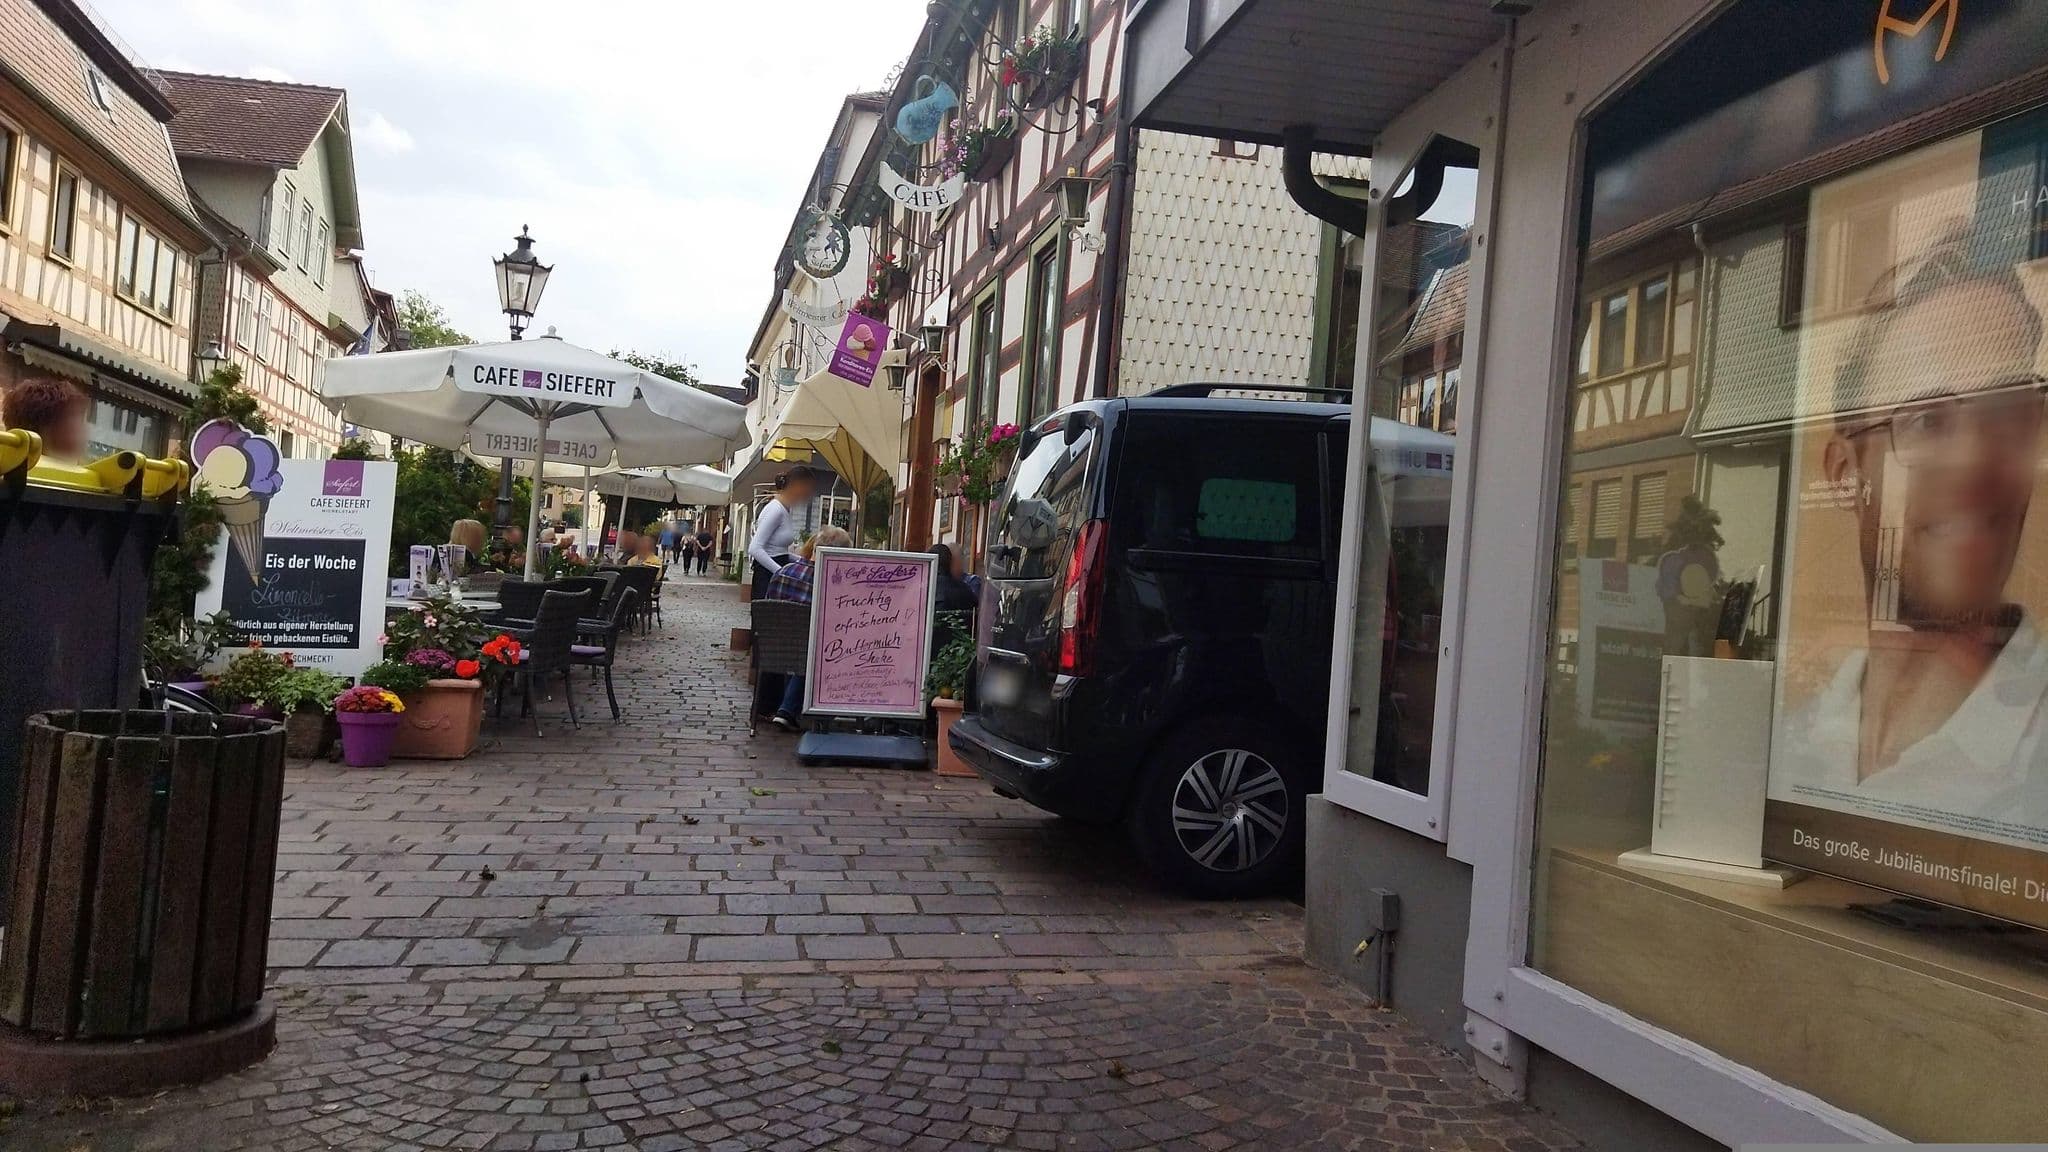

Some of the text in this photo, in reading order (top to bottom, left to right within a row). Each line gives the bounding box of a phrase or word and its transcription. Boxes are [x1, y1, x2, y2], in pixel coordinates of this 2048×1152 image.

[473, 365, 519, 387] CAFE
[546, 372, 617, 398] SIEFERT
[310, 498, 371, 509] CAFE SIEFERT
[265, 553, 357, 570] Eis der Woche
[263, 621, 277, 630] aus
[278, 621, 308, 632] eigener
[310, 621, 354, 633] Herstellung
[274, 633, 321, 644] gebackenen
[1793, 829, 2048, 903] Das große Jubiläumsfinale! Di
